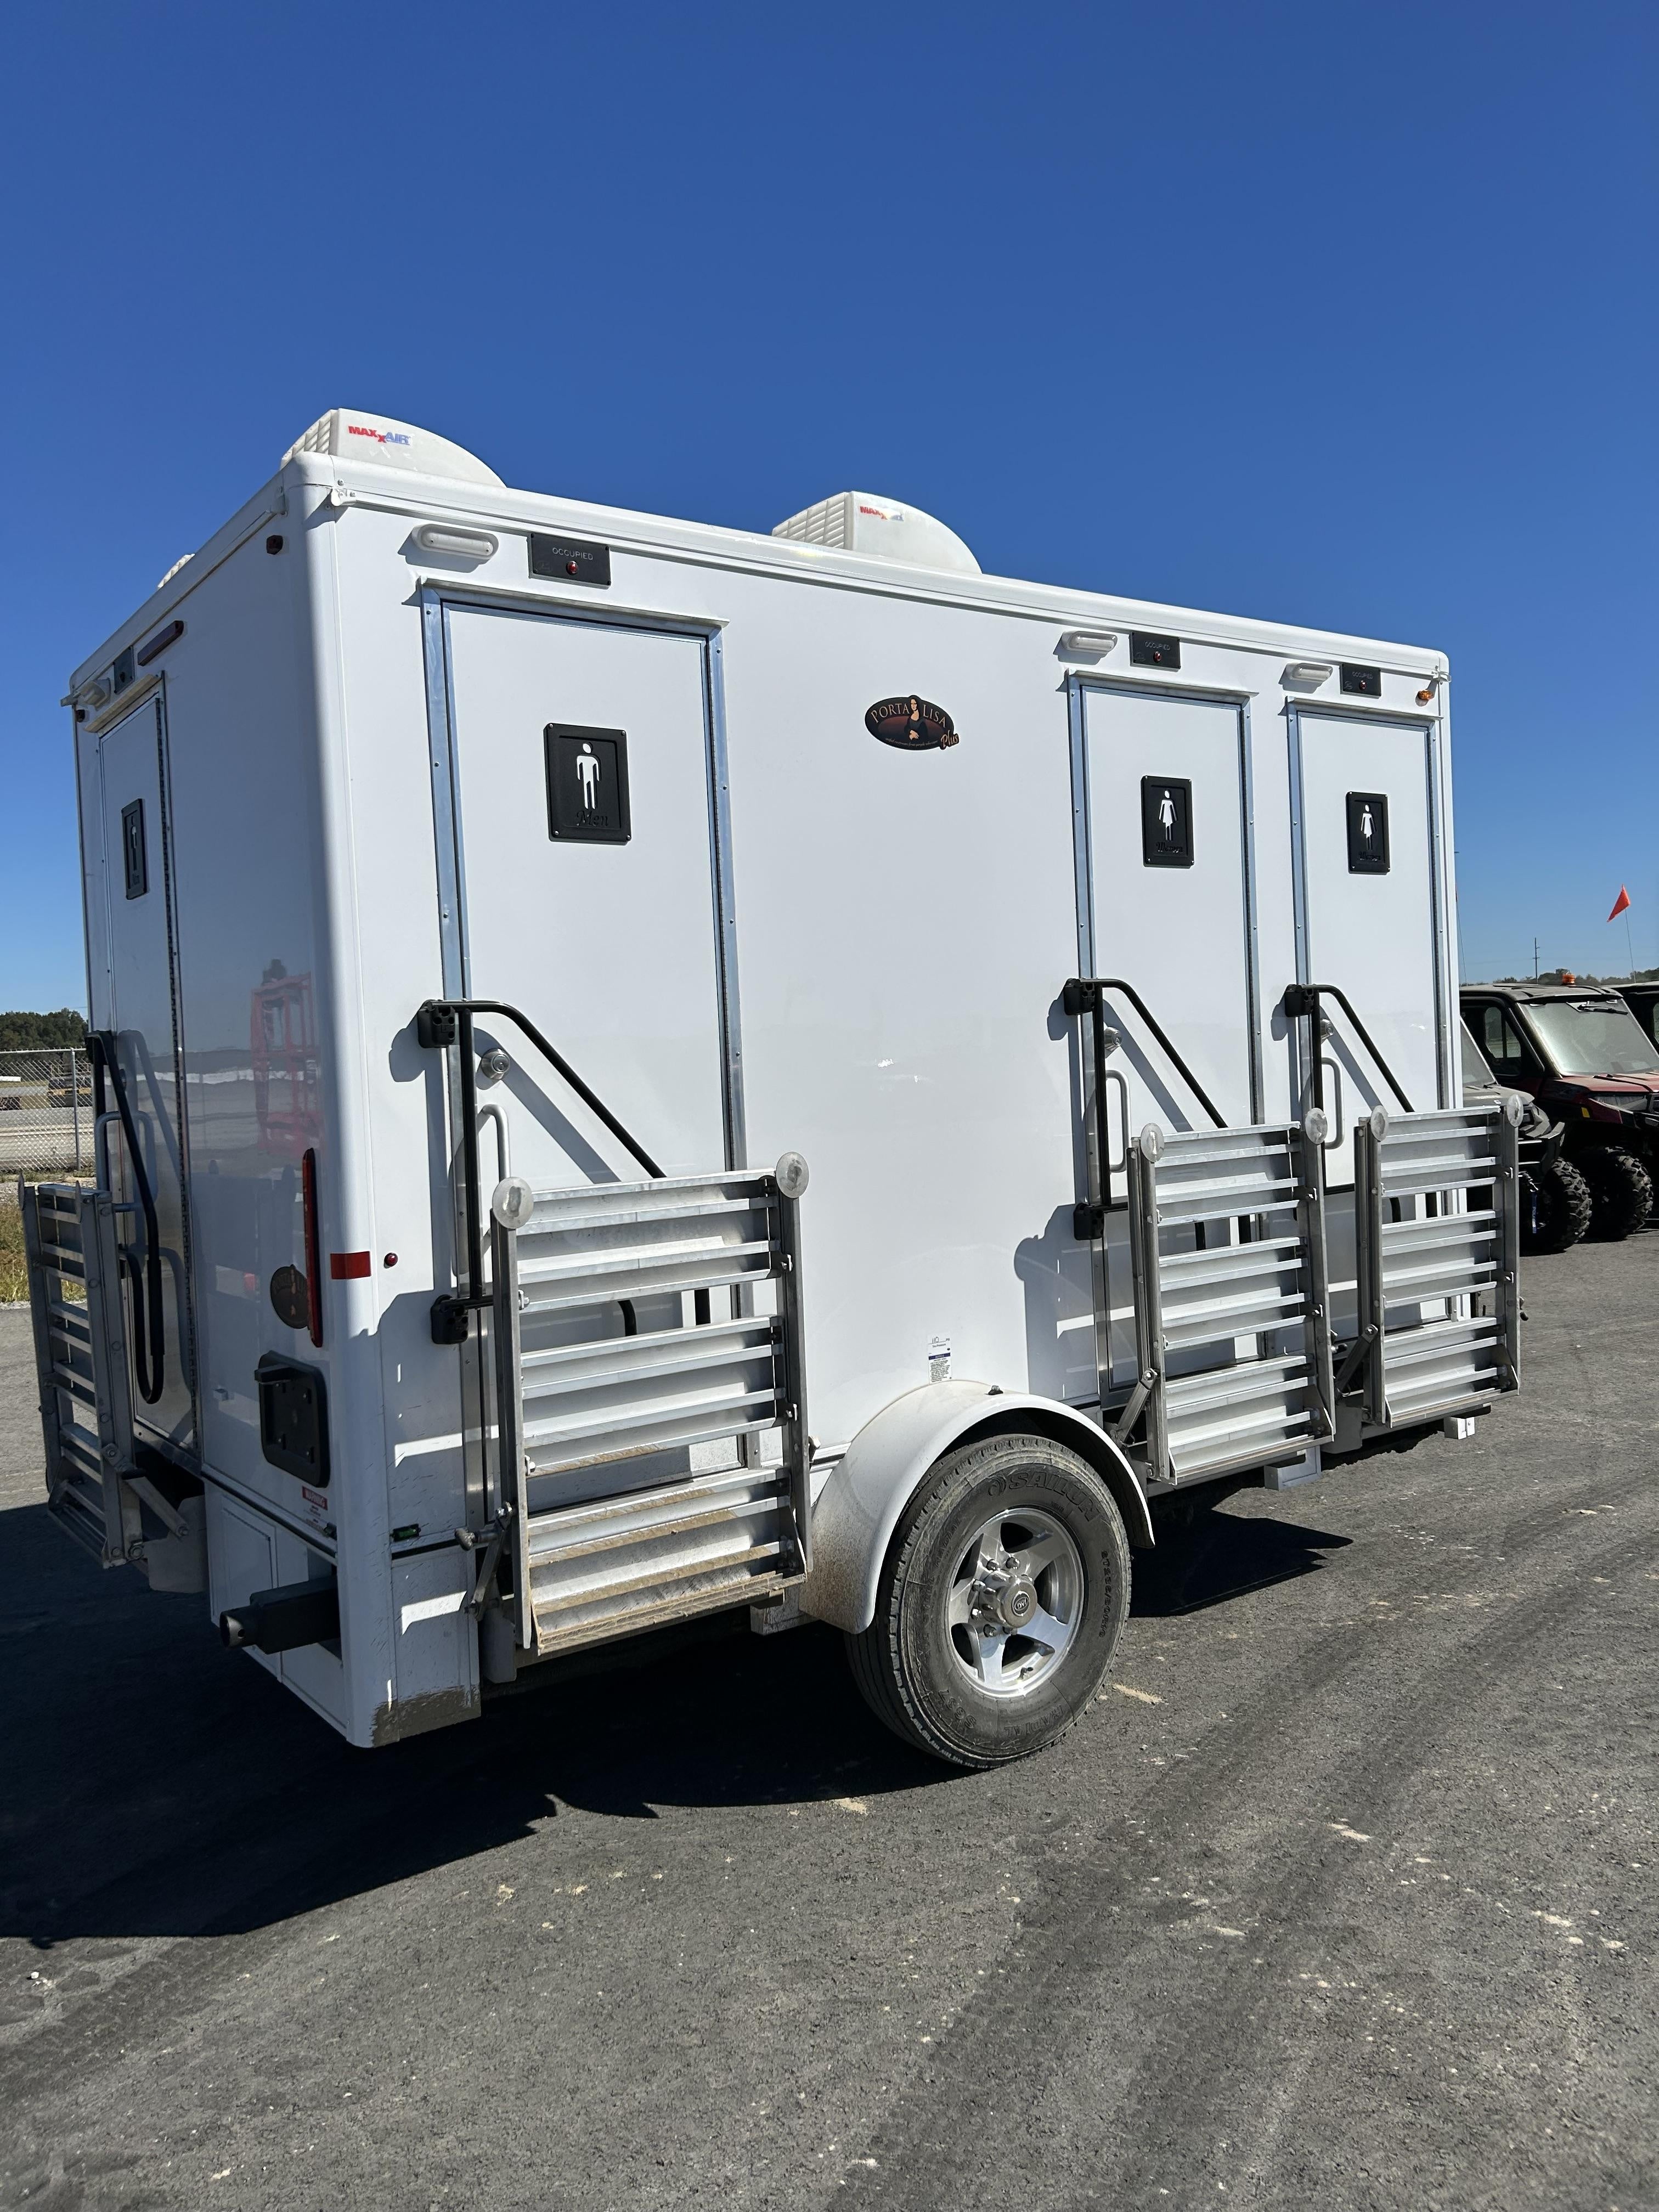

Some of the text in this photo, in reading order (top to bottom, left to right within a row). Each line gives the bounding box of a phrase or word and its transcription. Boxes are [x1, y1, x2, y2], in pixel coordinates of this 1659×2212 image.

[552, 548, 594, 560] OCCUPIED
[1145, 641, 1171, 651] OCCUPIED
[871, 703, 946, 728] PORTA LISA
[940, 730, 960, 749] Plus
[577, 810, 609, 827] Men
[1156, 842, 1184, 853] Women
[1009, 1471, 1101, 1522] SAILUN
[1004, 1705, 1063, 1737] RADIAL
